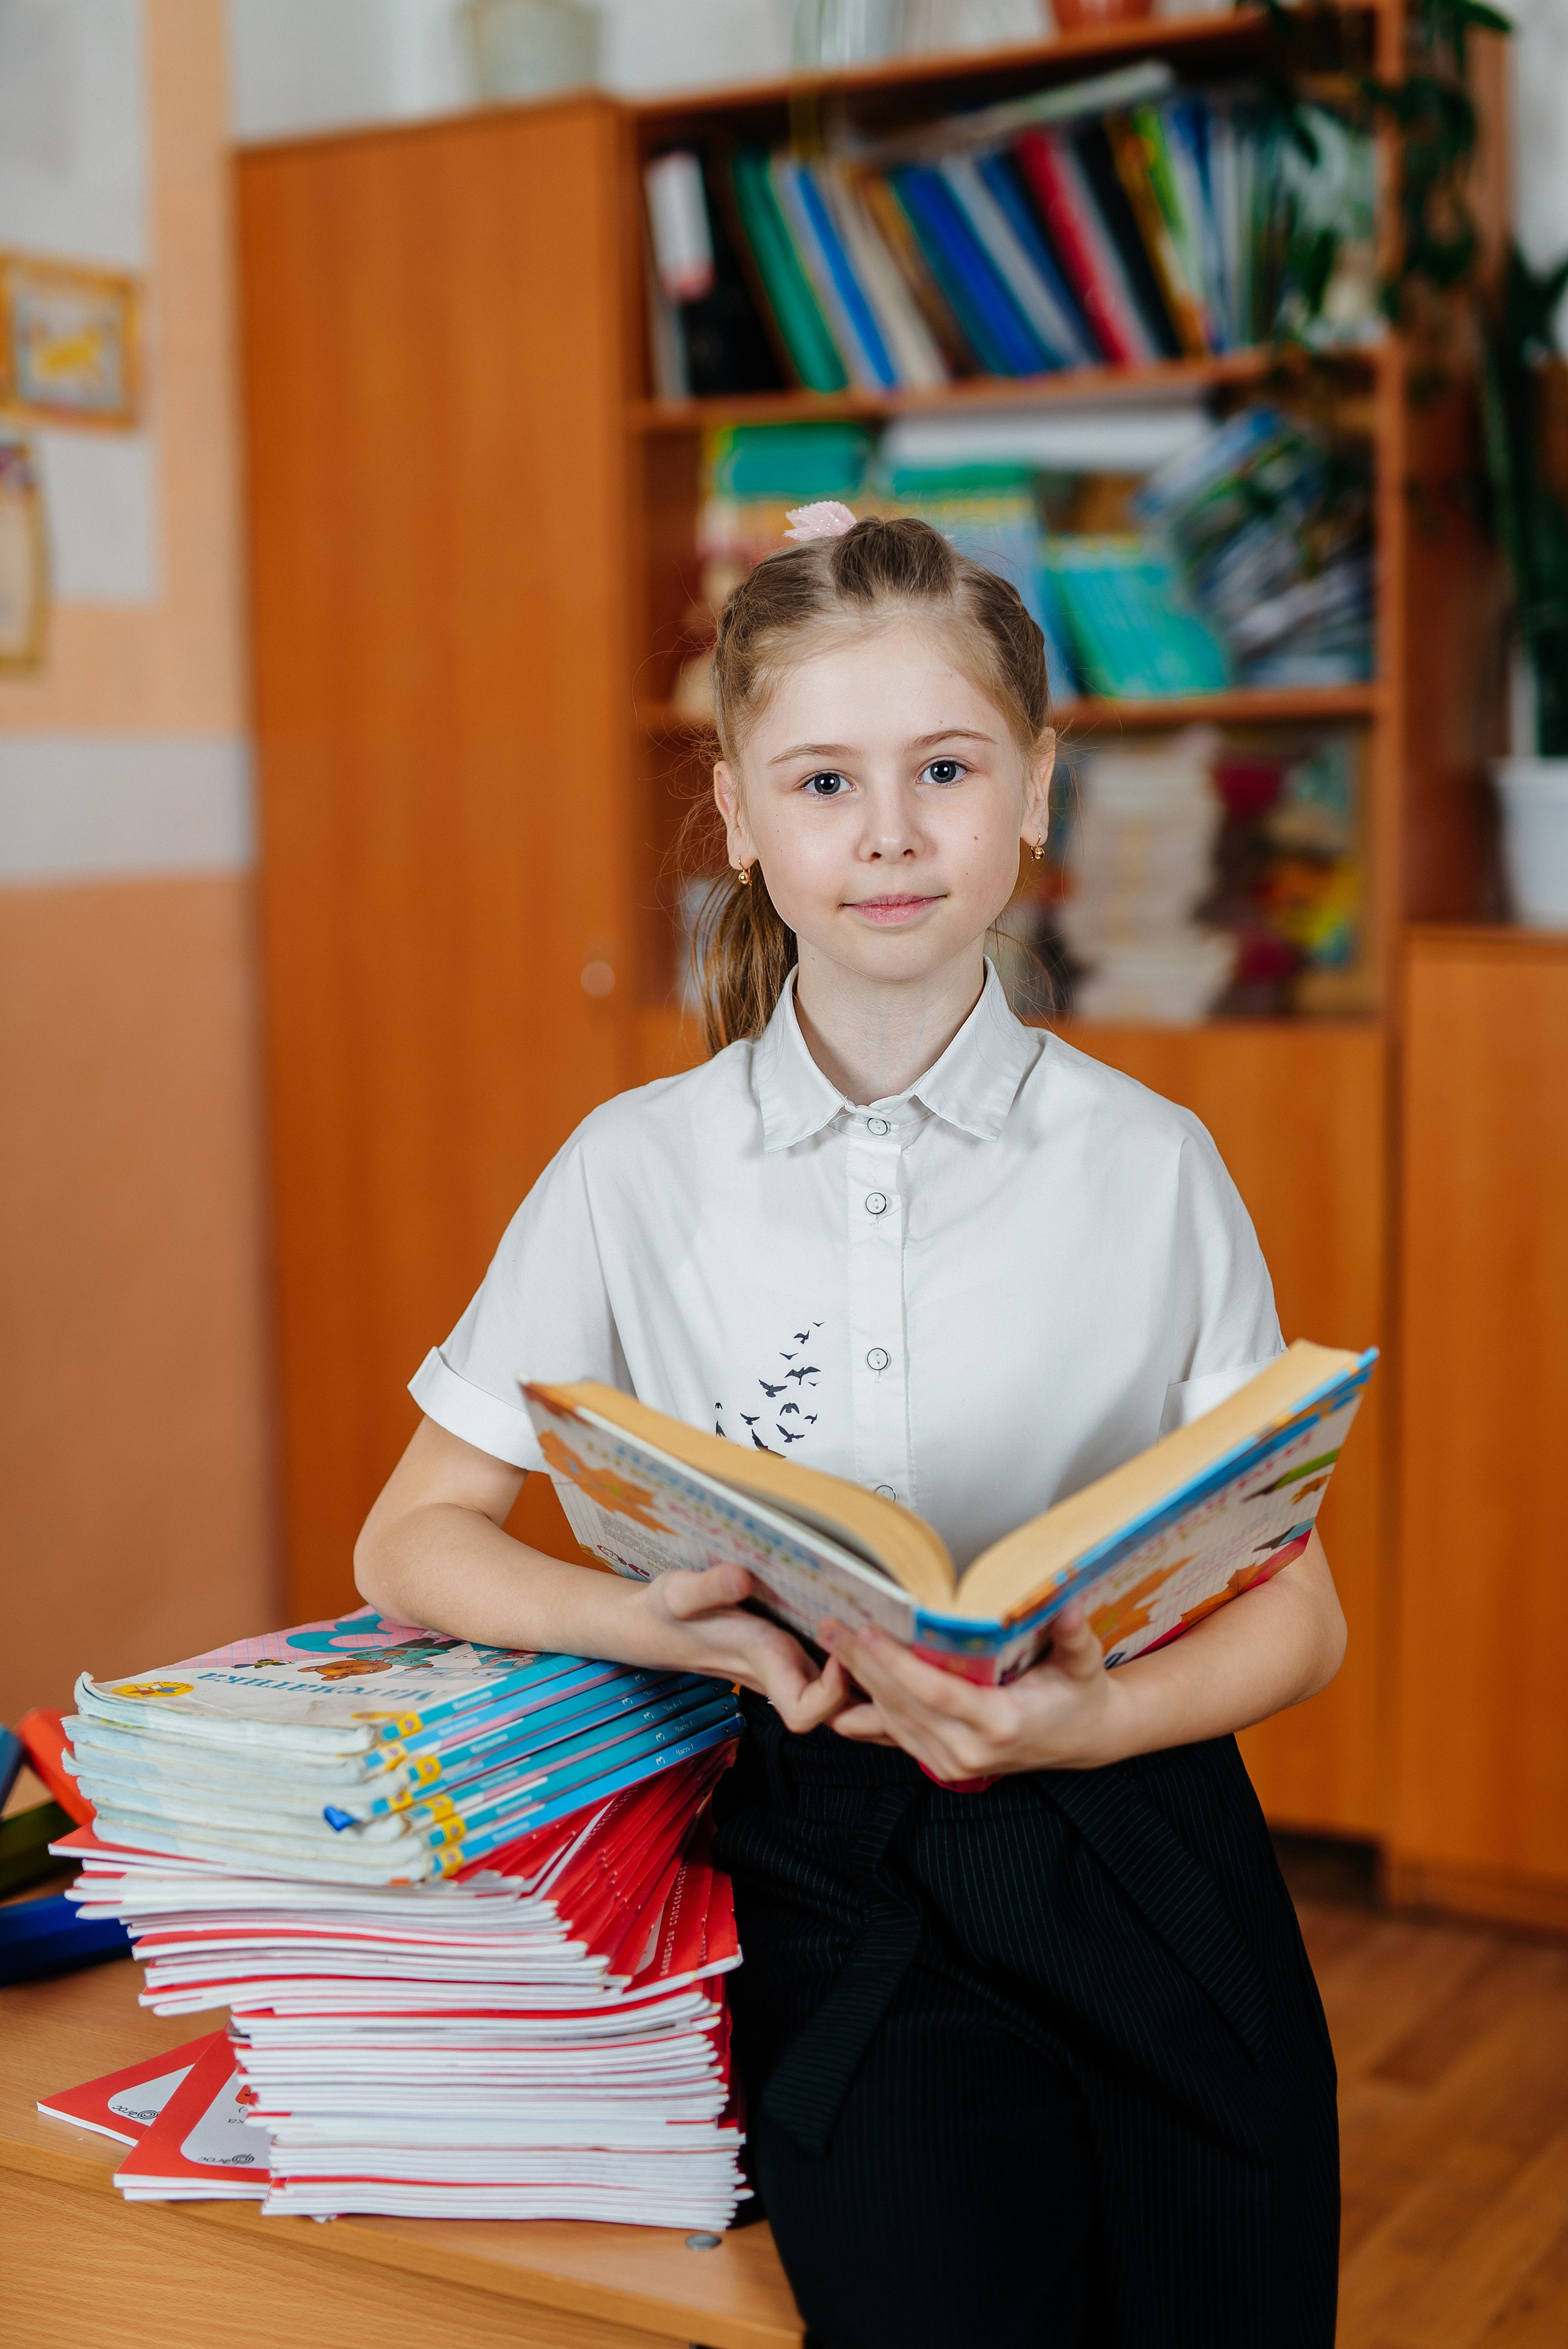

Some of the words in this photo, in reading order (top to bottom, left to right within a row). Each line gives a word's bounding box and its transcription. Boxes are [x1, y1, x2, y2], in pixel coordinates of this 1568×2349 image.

[197, 1672, 446, 1702] Математика
[635, 1674, 645, 1683] 3
[622, 1697, 633, 1706] 3
[644, 1711, 654, 1721] 3
[663, 1702, 679, 1711] Часть
[655, 1732, 665, 1742] 3
[674, 1723, 689, 1732] Часть
[655, 1755, 666, 1766] 3
[675, 1746, 691, 1756] Часть
